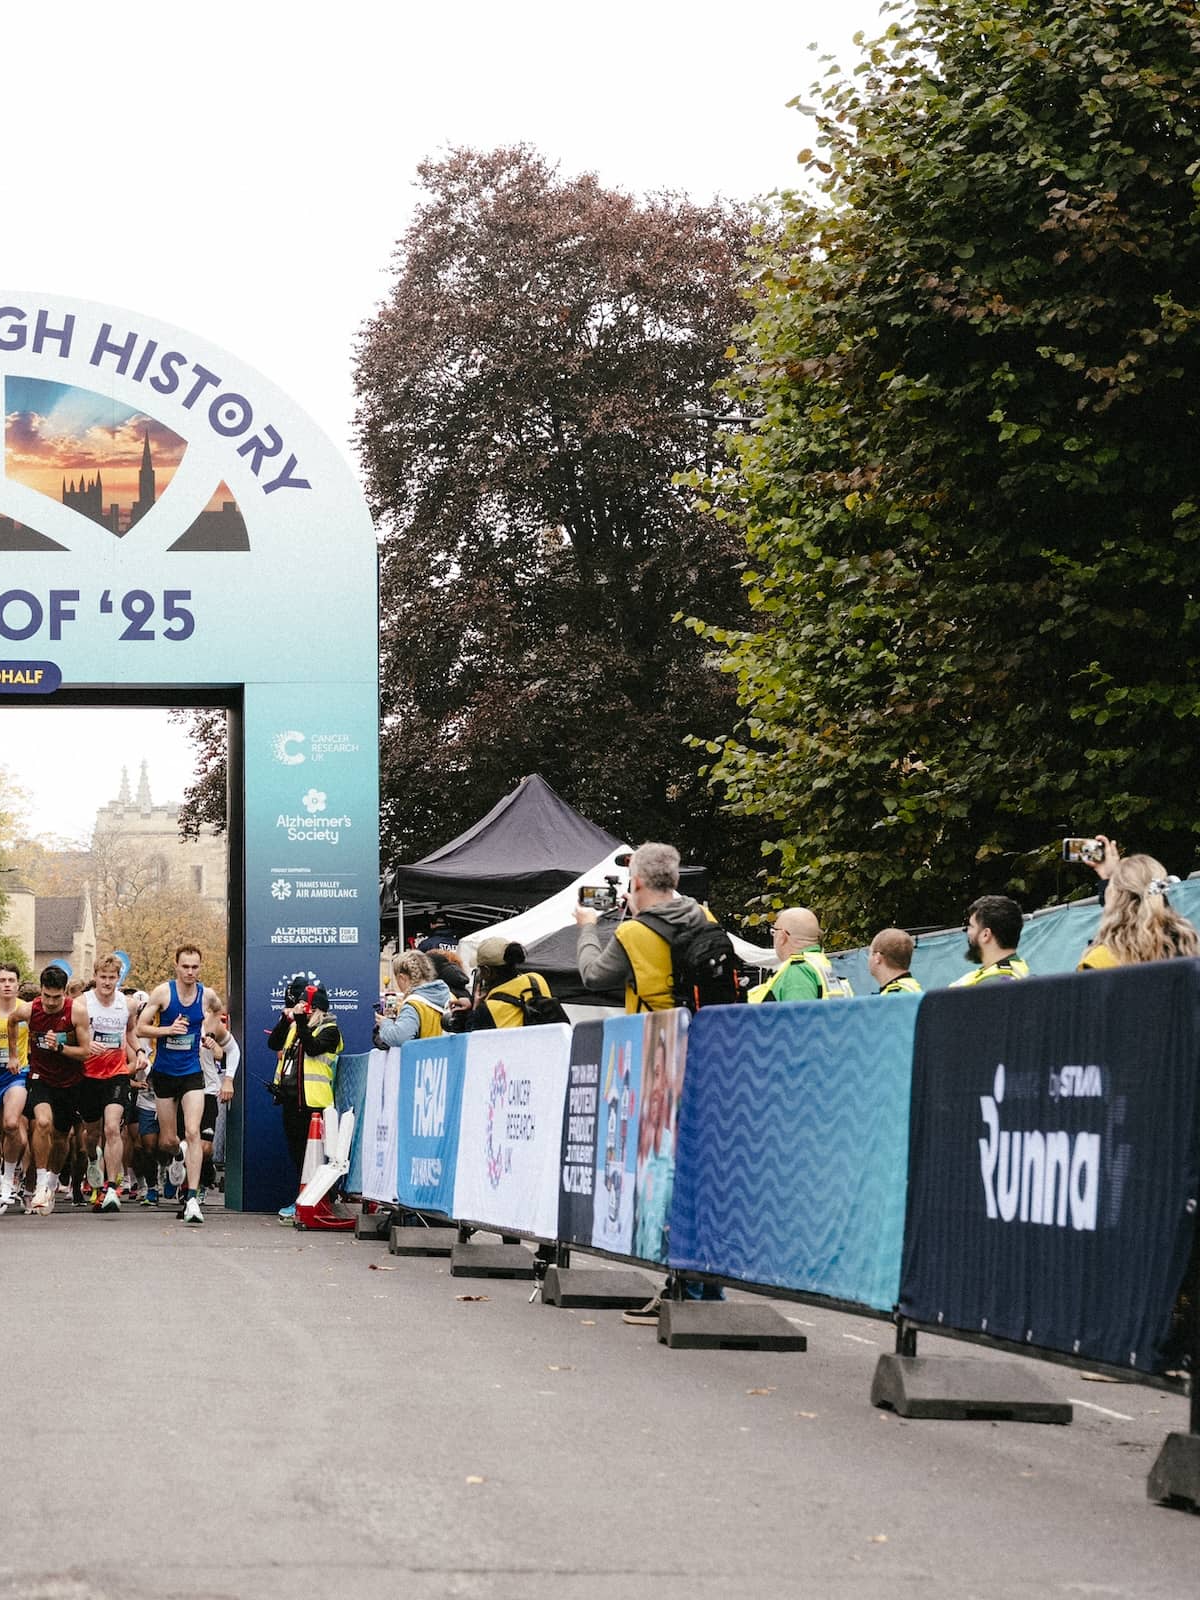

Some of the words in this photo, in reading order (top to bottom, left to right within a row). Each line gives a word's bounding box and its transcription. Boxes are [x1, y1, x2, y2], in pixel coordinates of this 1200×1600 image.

[89, 322, 312, 496] HISTORY
[311, 734, 349, 743] CANCER
[311, 743, 359, 752] RESEARCH
[311, 753, 325, 761] UK
[276, 814, 352, 828] Alzheimer's
[287, 827, 339, 844] Society
[295, 888, 309, 898] AIR
[310, 888, 359, 898] AMBULANCE
[274, 926, 337, 935] ALZHEIMER'S
[271, 935, 321, 944] RESEARCH
[323, 935, 337, 944] UK
[978, 1063, 1101, 1231] Runna
